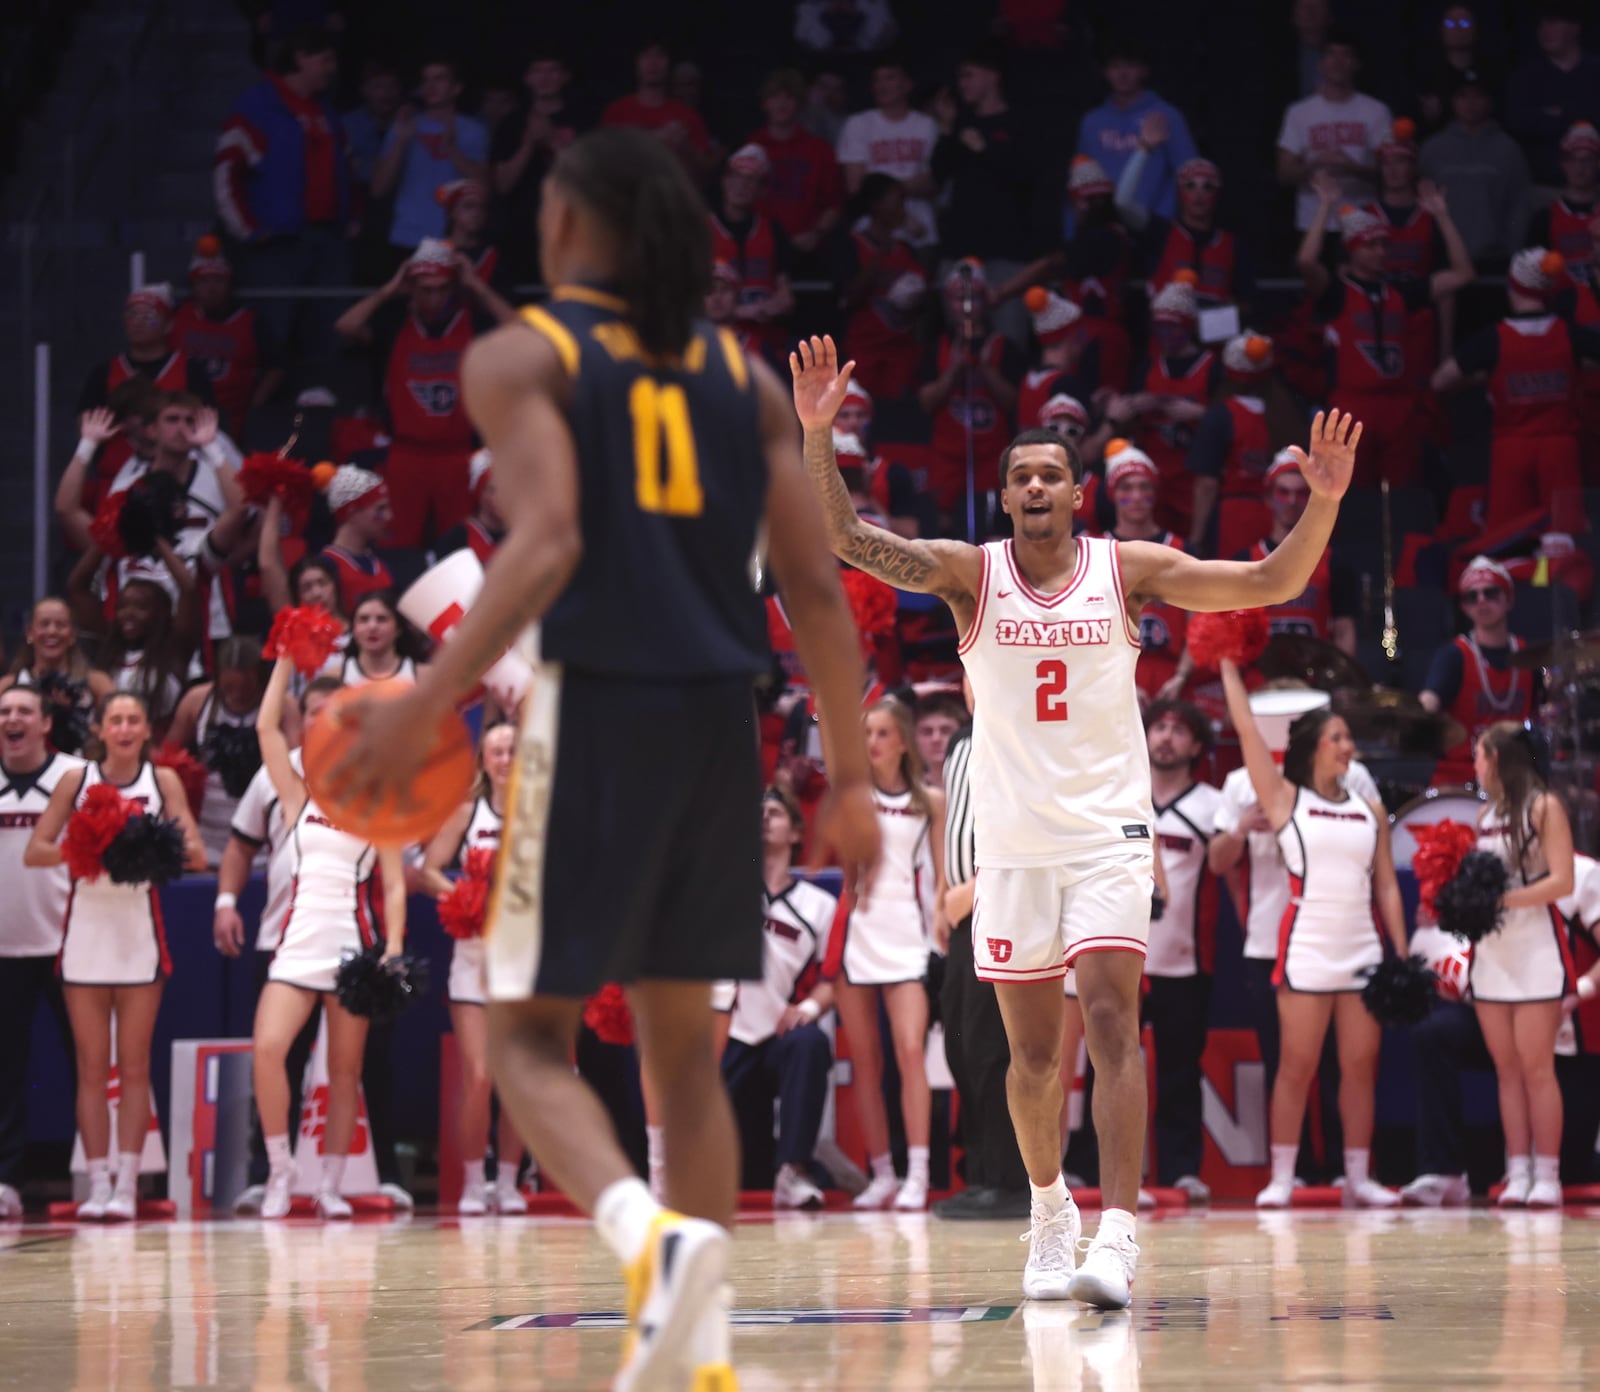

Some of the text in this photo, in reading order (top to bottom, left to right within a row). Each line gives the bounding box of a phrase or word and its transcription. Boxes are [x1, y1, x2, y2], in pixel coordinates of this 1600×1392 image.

[844, 532, 930, 586] SACRIFICE
[995, 619, 1112, 648] DAYTON
[1036, 660, 1068, 722] 2
[986, 937, 1013, 963] D
